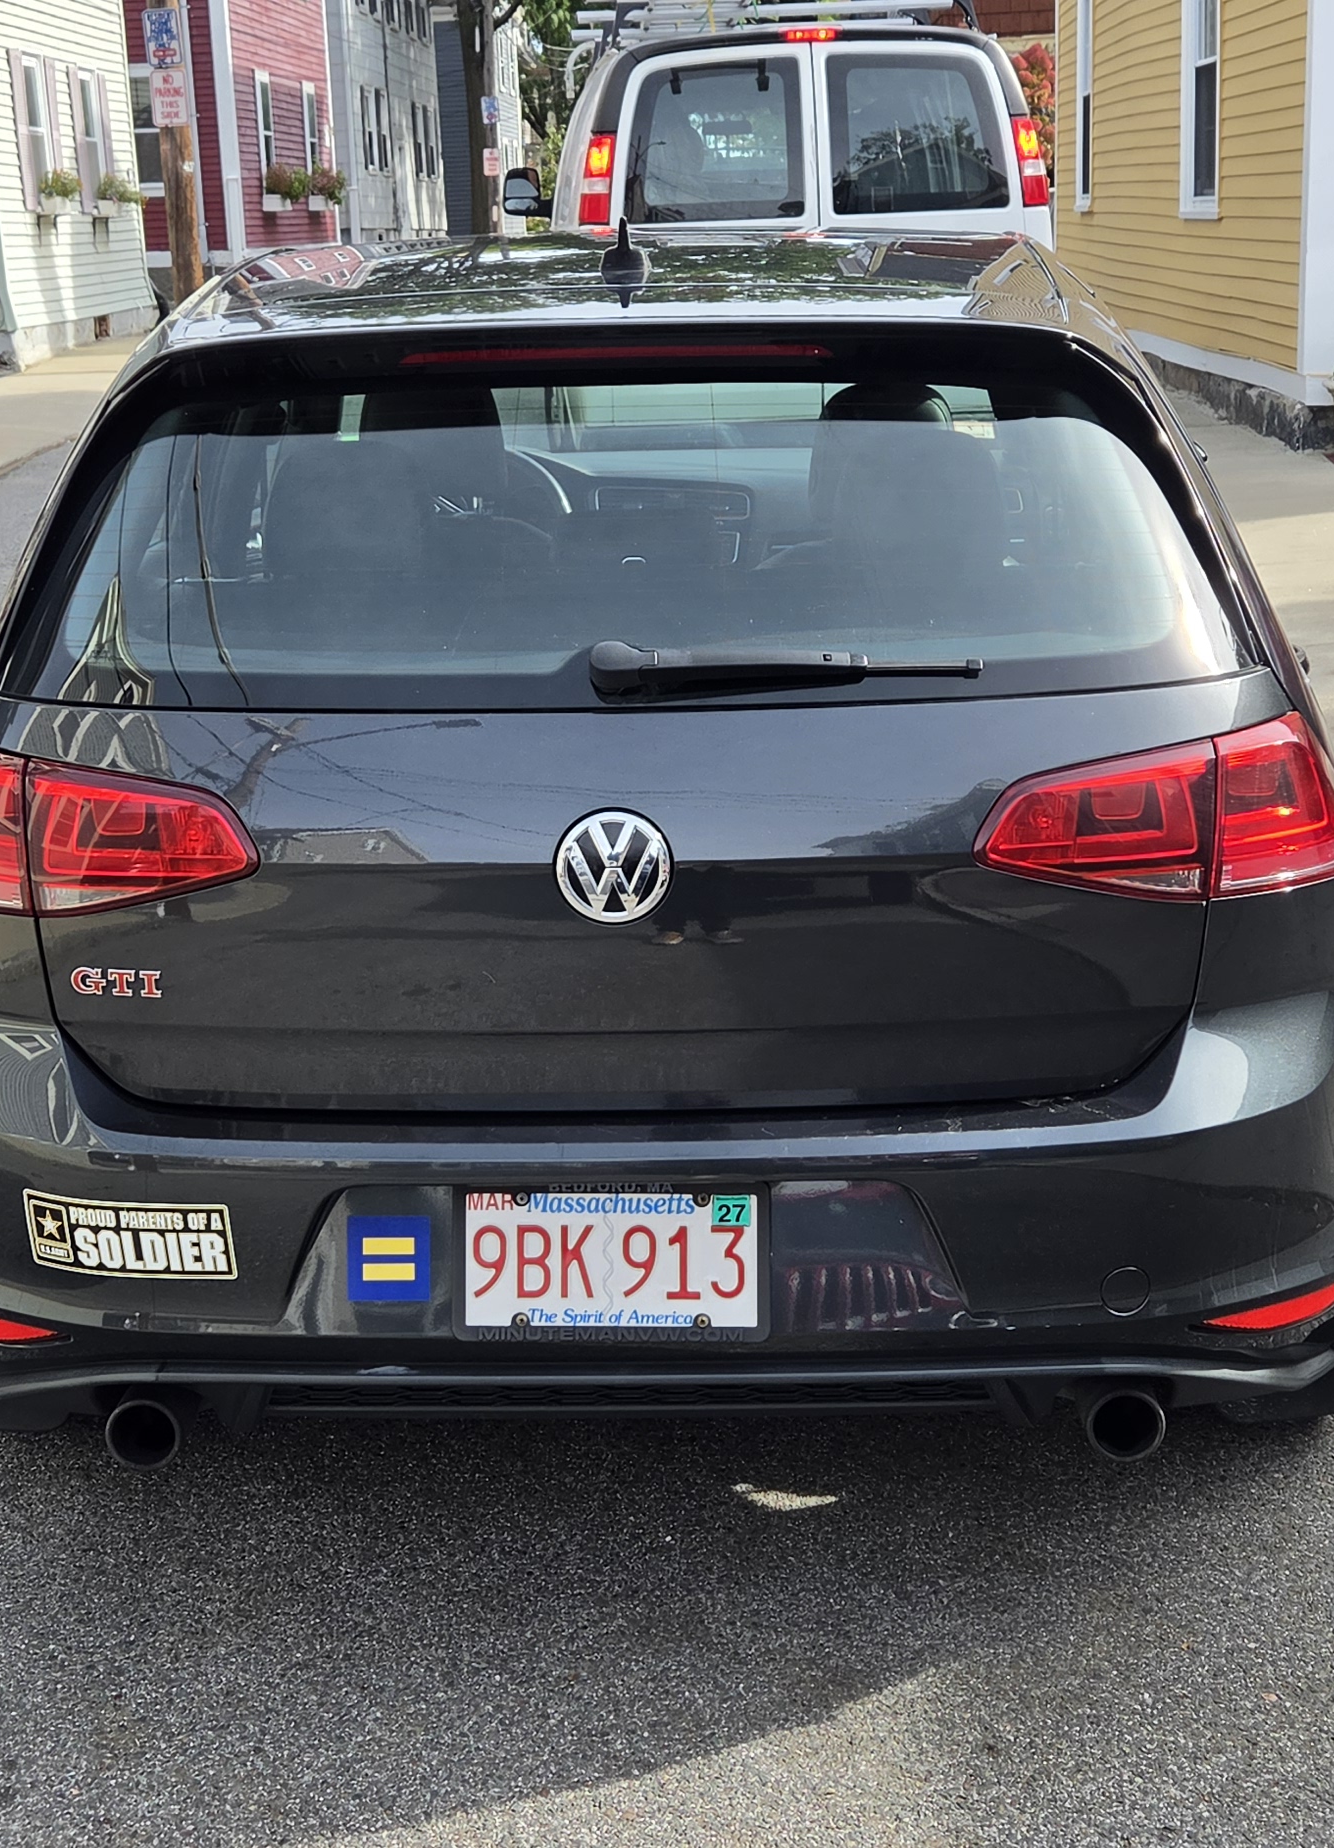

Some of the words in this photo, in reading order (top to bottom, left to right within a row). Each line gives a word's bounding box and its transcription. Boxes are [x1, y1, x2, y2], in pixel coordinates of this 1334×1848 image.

[162, 74, 174, 85] NO
[154, 86, 184, 98] PARKING
[160, 100, 180, 109] THIS
[160, 111, 181, 119] SIDE
[71, 966, 163, 998] GTI
[646, 1182, 674, 1193] MA
[468, 1193, 514, 1211] MAR
[527, 1193, 696, 1215] Massachusetts
[718, 1204, 746, 1223] 27
[68, 1206, 117, 1228] PROUD
[119, 1210, 185, 1230] PARENTS
[187, 1212, 207, 1231] OF
[210, 1212, 224, 1230] A
[73, 1227, 229, 1272] SOLDIER
[473, 1225, 595, 1299] 9BK
[622, 1225, 746, 1300] 913
[528, 1307, 558, 1324] The
[561, 1307, 604, 1327] Spirit
[608, 1309, 625, 1327] of
[627, 1309, 694, 1325] America
[478, 1327, 744, 1342] MINUTEMANVW.COM
